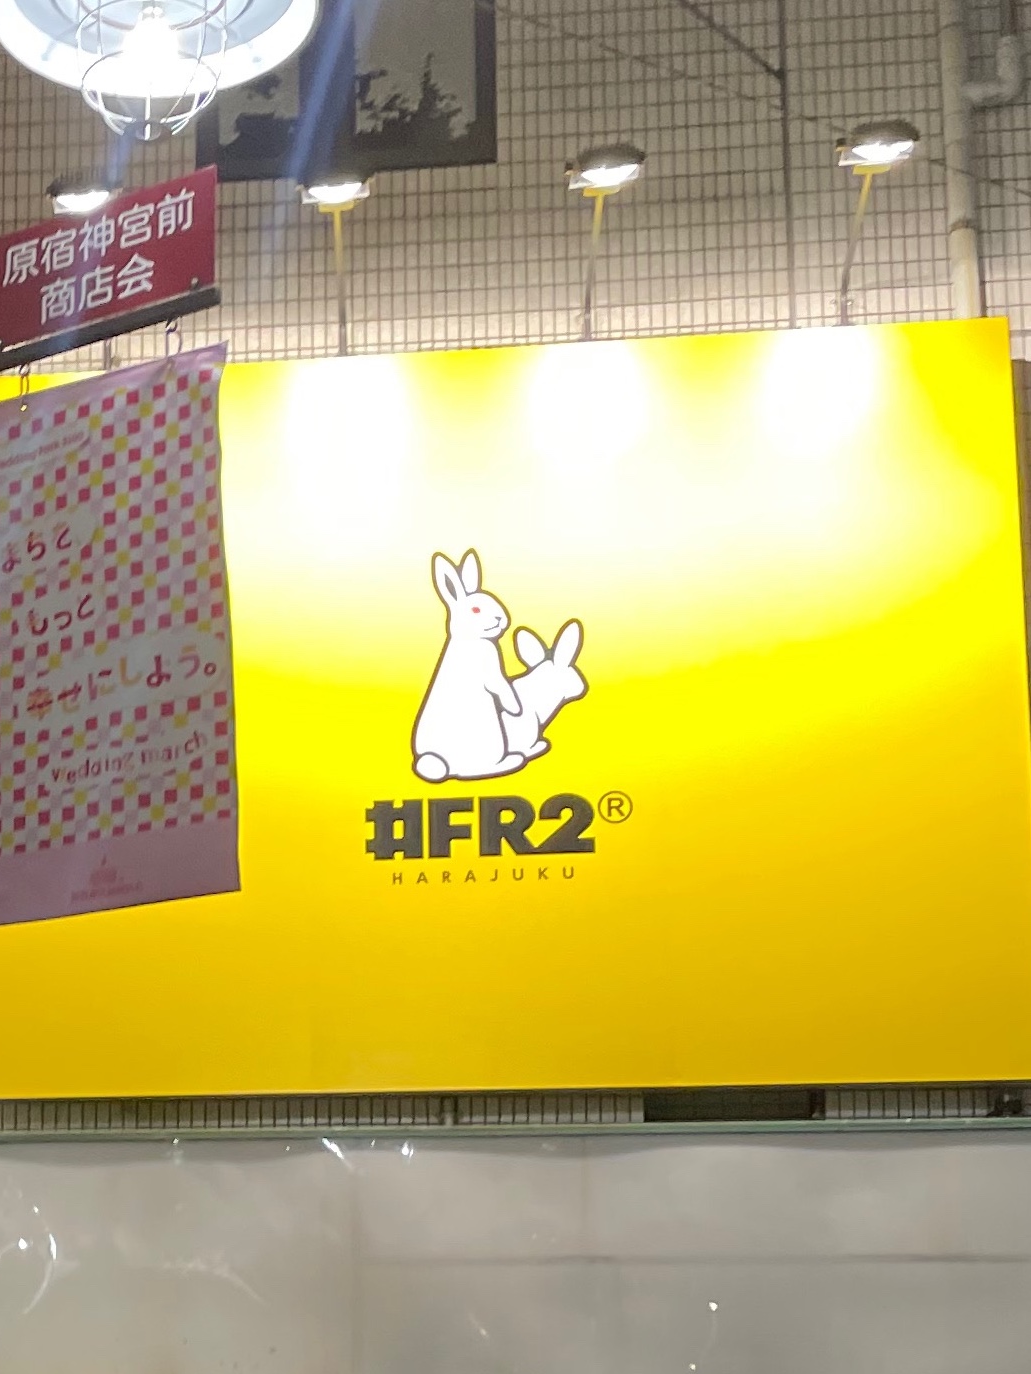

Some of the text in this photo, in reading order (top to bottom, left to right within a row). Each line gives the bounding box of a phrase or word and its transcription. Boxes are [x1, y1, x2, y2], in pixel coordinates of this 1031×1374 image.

[2, 187, 195, 287] 原宿神宮前
[40, 252, 155, 325] 商店会
[391, 866, 575, 885] HARAJUKU
